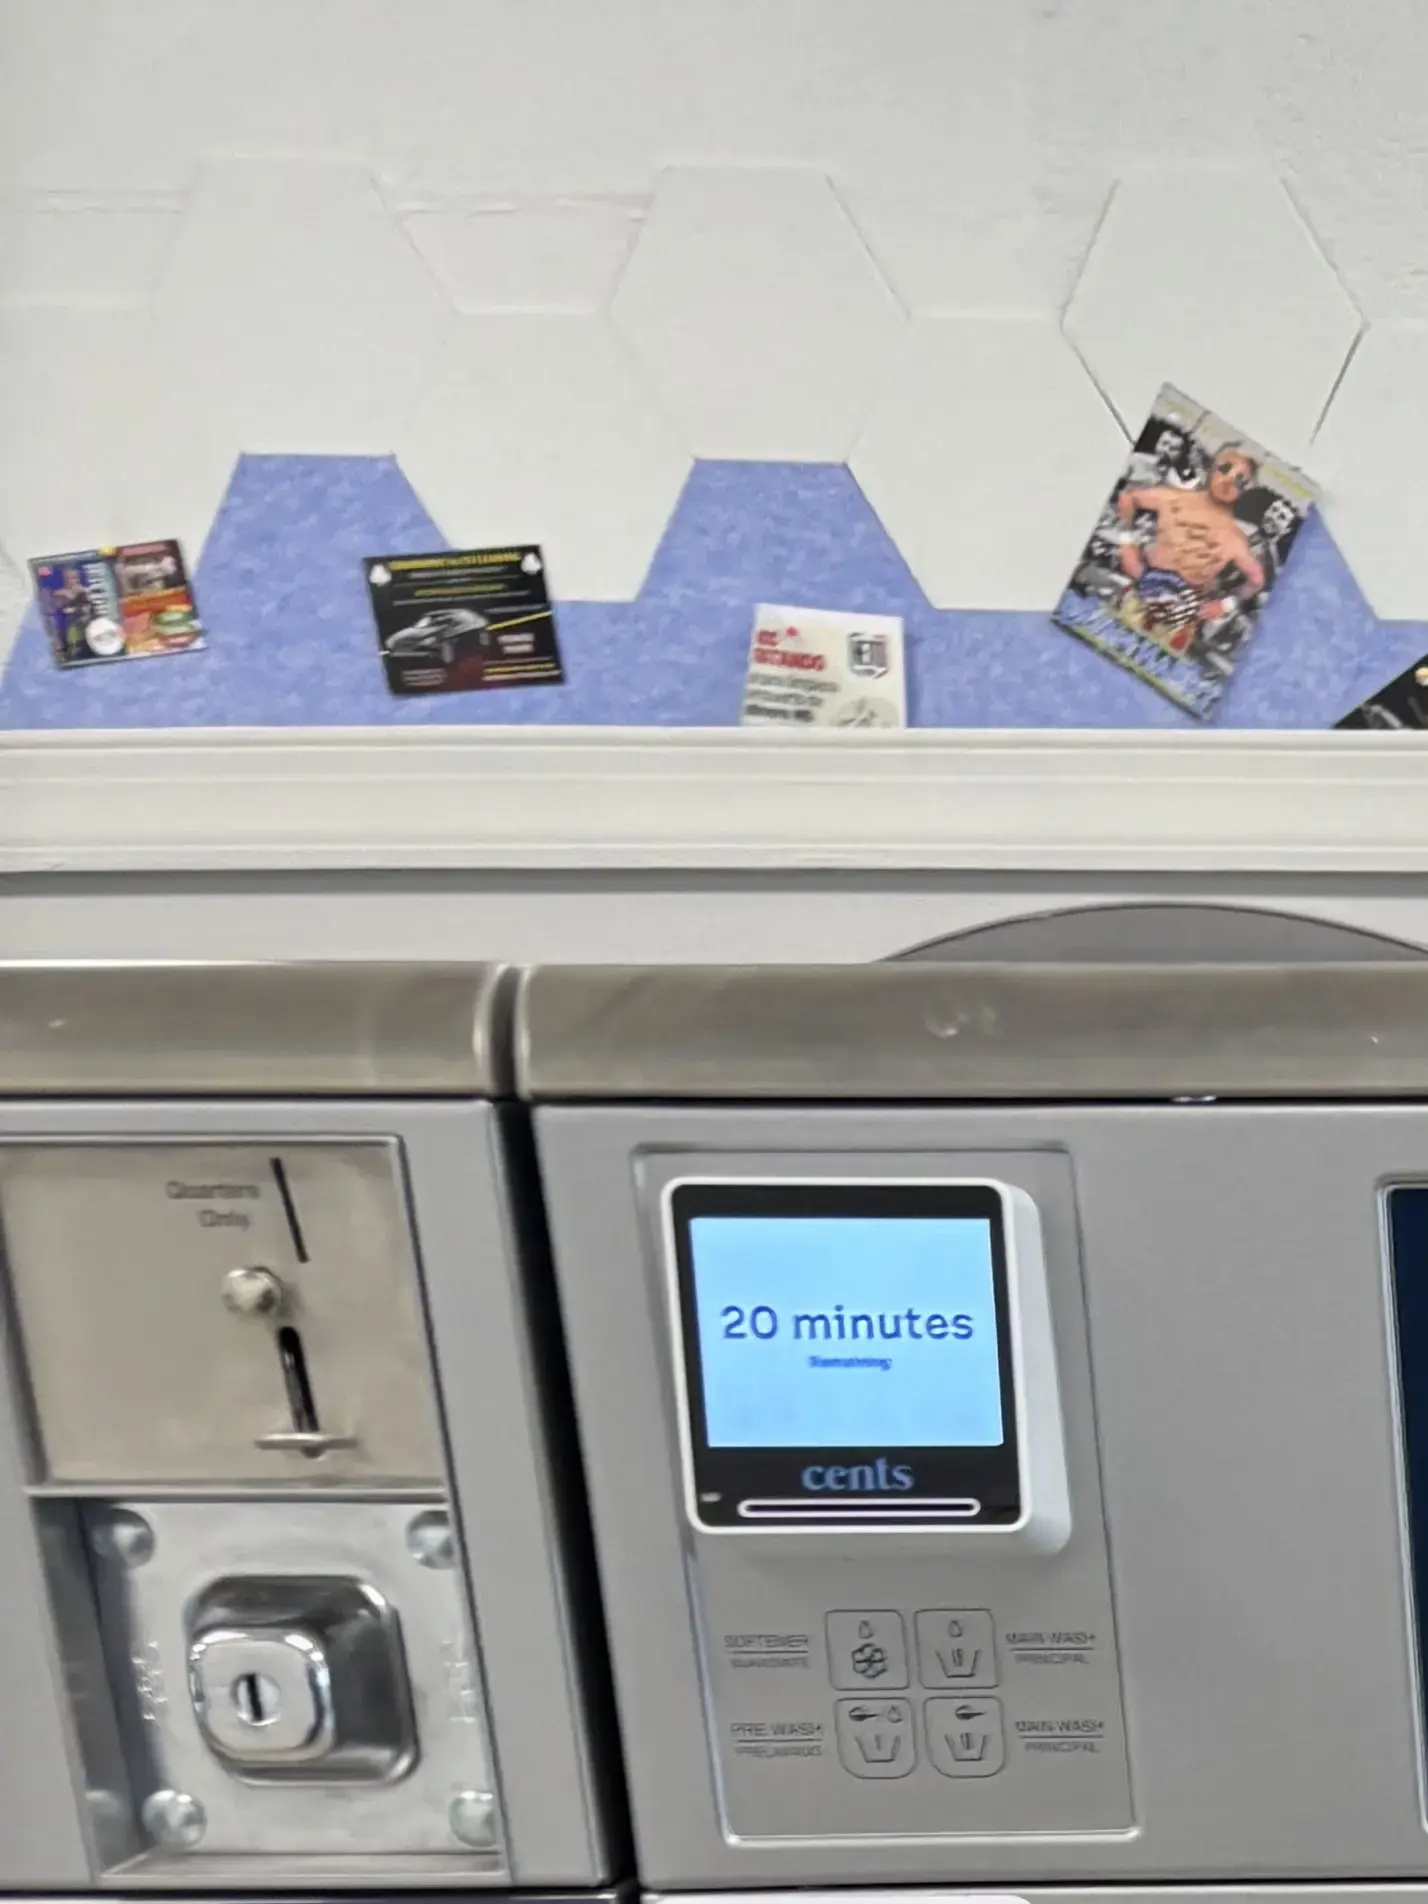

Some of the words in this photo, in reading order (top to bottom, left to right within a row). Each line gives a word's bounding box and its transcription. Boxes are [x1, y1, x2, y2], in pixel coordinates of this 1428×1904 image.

[166, 1180, 260, 1200] Quarters
[199, 1209, 251, 1232] Only
[720, 1305, 778, 1340] 20
[792, 1304, 974, 1340] minutes
[801, 1457, 915, 1490] cents
